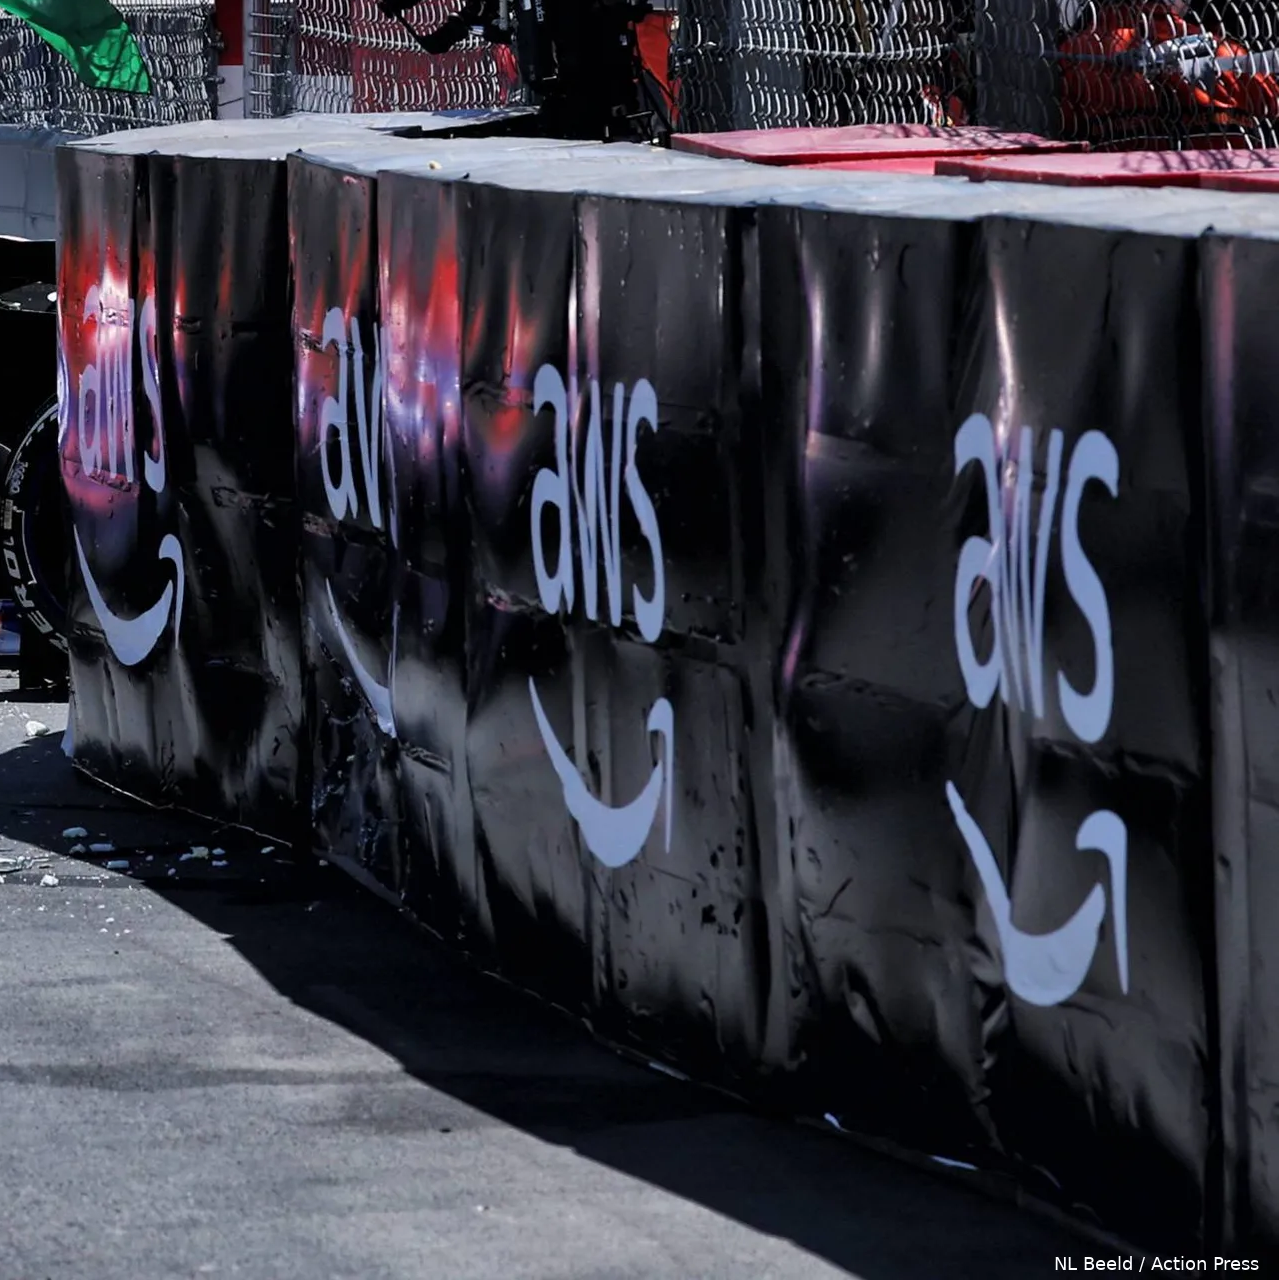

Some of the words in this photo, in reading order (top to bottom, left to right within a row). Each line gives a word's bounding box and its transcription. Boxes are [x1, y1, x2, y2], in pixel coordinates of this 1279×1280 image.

[77, 284, 165, 493] aws
[531, 363, 667, 643] aws
[953, 411, 1120, 744] aws
